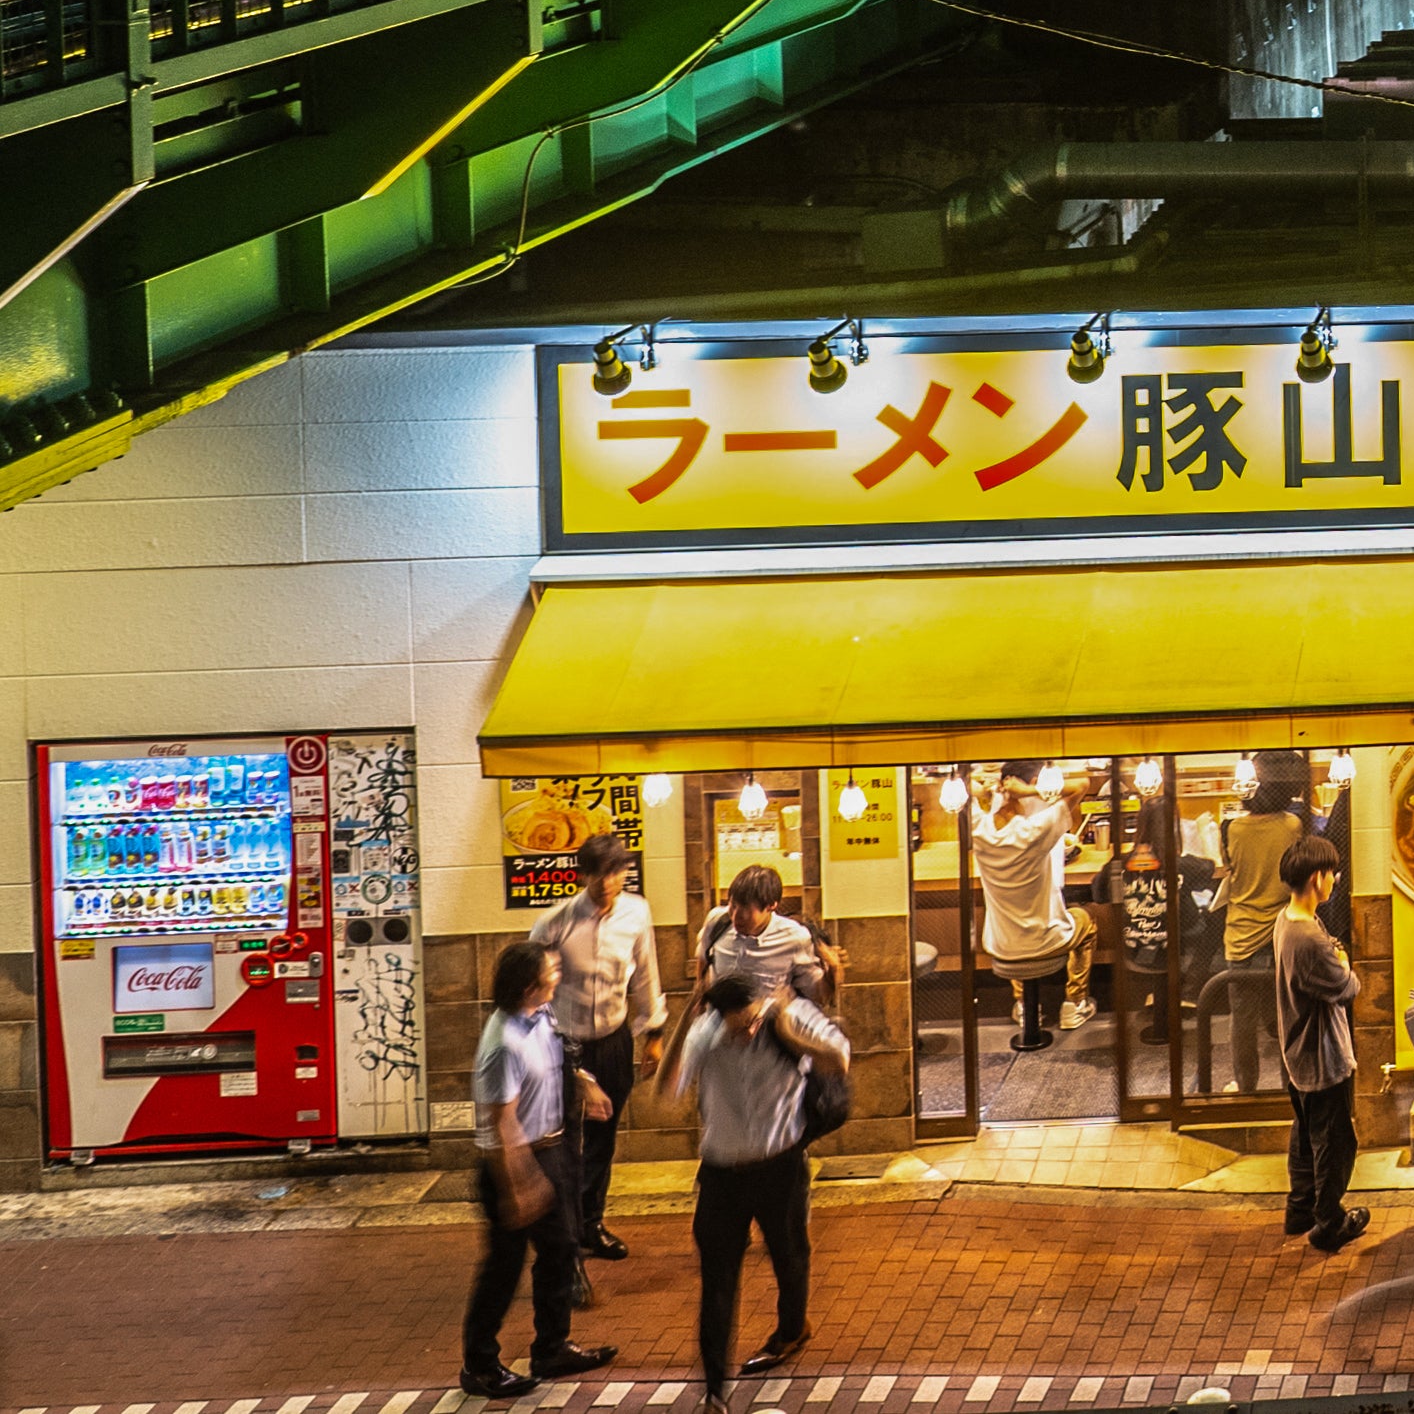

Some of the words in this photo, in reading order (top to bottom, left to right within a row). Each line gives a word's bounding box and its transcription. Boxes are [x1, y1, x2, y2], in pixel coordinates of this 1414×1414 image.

[598, 364, 1401, 504] ラーメン豚山
[526, 870, 577, 884] 1,400
[127, 965, 208, 992] Coca-Cola
